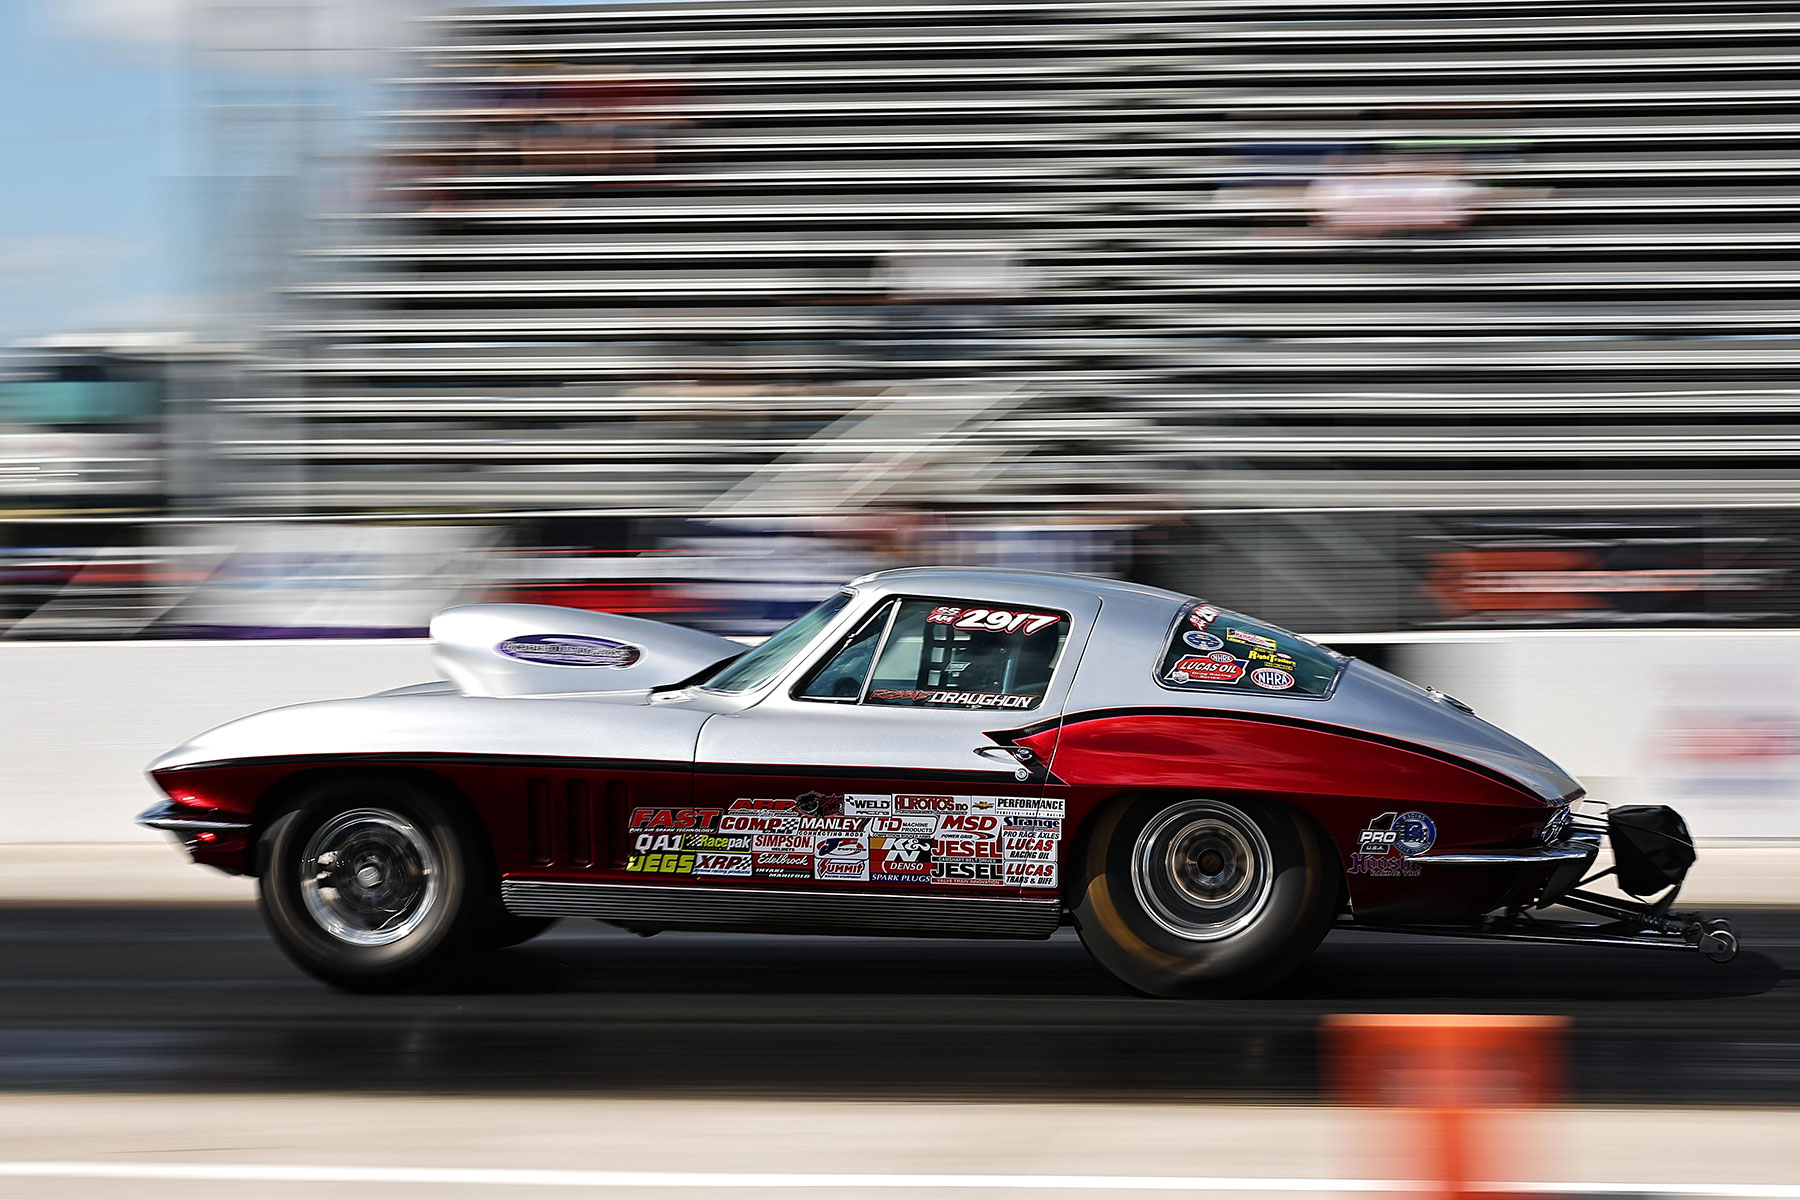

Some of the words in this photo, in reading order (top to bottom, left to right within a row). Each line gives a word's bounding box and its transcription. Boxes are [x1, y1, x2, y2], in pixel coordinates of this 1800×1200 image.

[936, 607, 960, 615] SS
[928, 614, 954, 622] AM
[955, 609, 1058, 633] 2917
[1211, 654, 1233, 663] NHRA
[1180, 661, 1219, 671] LUCAS
[1219, 664, 1237, 673] OIL
[1259, 672, 1288, 685] NHRA
[928, 691, 1034, 707] DRAUGHON
[728, 798, 797, 811] ARP
[855, 801, 890, 809] WELD
[997, 798, 1064, 810] PERFORMANCE
[631, 809, 719, 828] FAST
[721, 817, 782, 831] COMP
[800, 818, 861, 831] MANLEY
[941, 815, 998, 831] MSD
[1003, 816, 1060, 828] Strange
[1019, 831, 1036, 839] RACE
[1038, 832, 1060, 840] AXLES
[1359, 831, 1397, 843] PRO
[634, 834, 682, 854] QA1
[700, 835, 751, 850] Racepak
[932, 840, 1003, 858] JESEL
[1005, 838, 1054, 852] LUCAS
[757, 853, 809, 867] Edelbrock
[1009, 850, 1036, 859] RACING
[1037, 851, 1050, 859] OIL
[626, 853, 696, 873] JEGS
[694, 855, 743, 870] XRP
[889, 862, 924, 871] DENSO
[930, 862, 1003, 880] JESEL
[1005, 863, 1054, 877] LUCAS
[871, 873, 898, 881] SPARK
[902, 875, 931, 883] PLUGS
[1005, 876, 1028, 884] TRANS
[1036, 877, 1053, 885] DIFF
